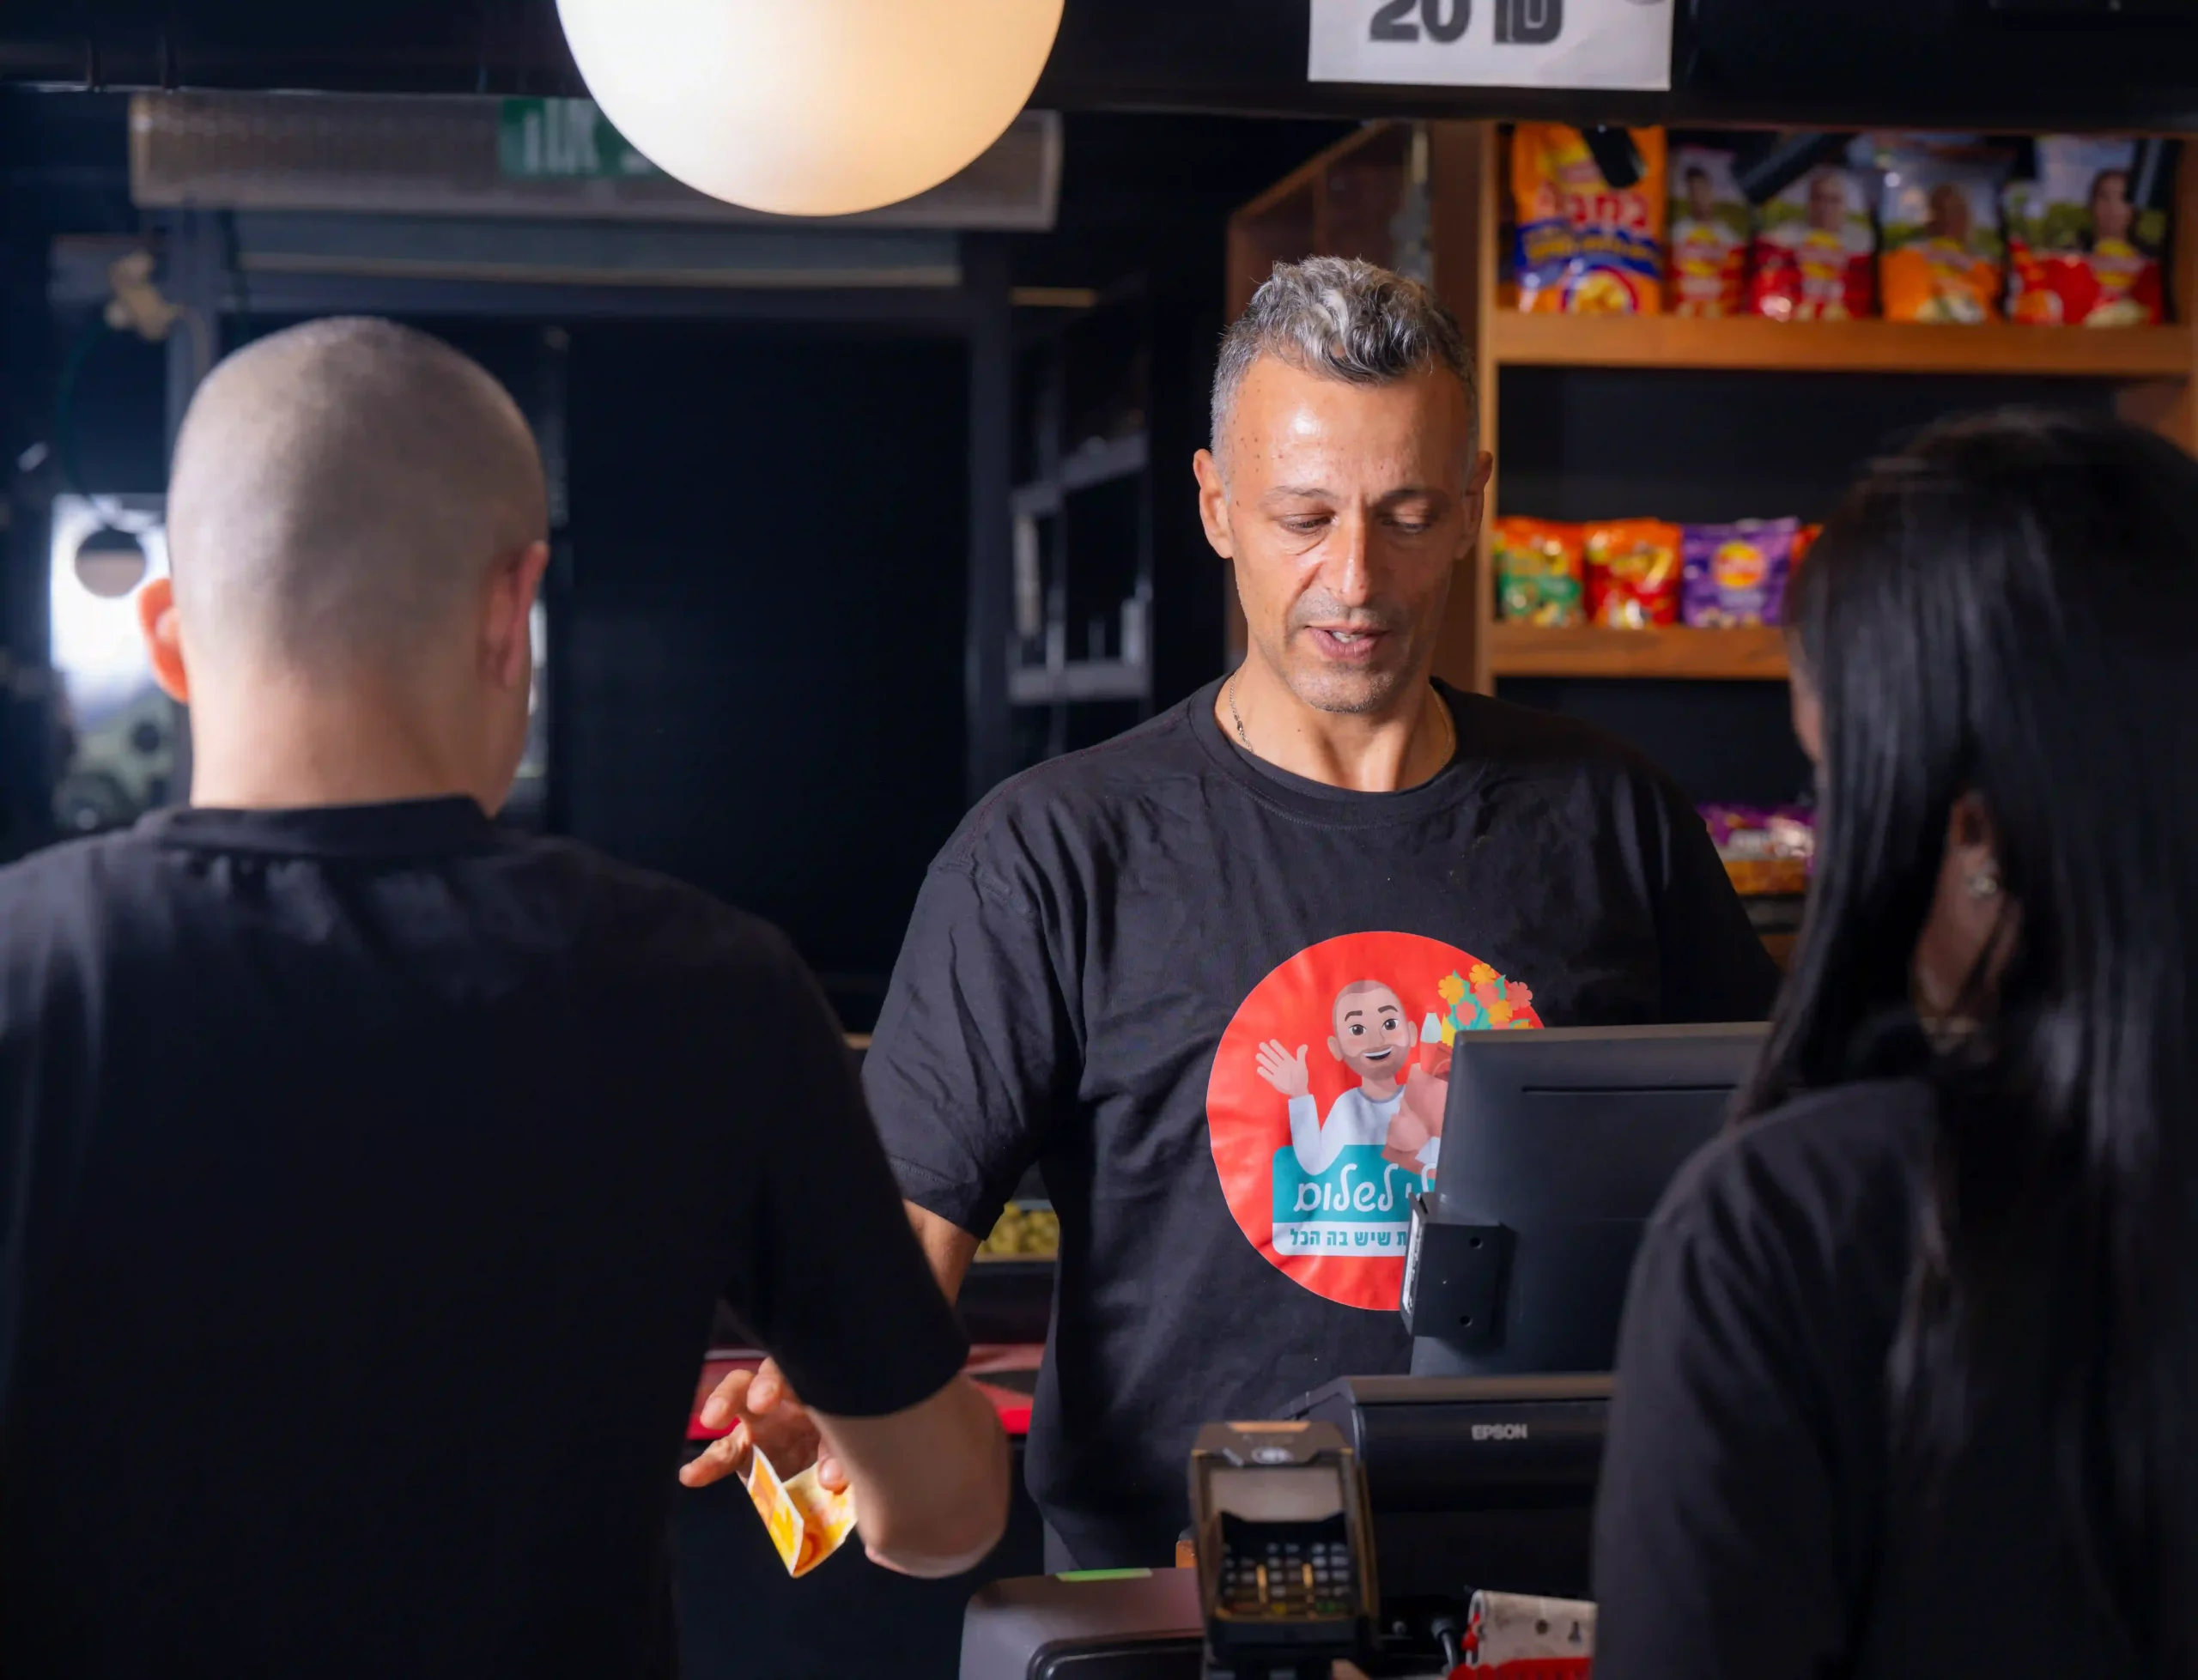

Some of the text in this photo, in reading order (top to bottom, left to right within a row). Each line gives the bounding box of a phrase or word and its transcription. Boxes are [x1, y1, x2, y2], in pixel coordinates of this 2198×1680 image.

[1369, 0, 1472, 44] 20
[1293, 1163, 1400, 1212] לשלום
[1290, 1228, 1321, 1246] הכל
[1327, 1230, 1348, 1246] בה
[1354, 1230, 1391, 1246] שיש
[1471, 1423, 1528, 1440] EPSON
